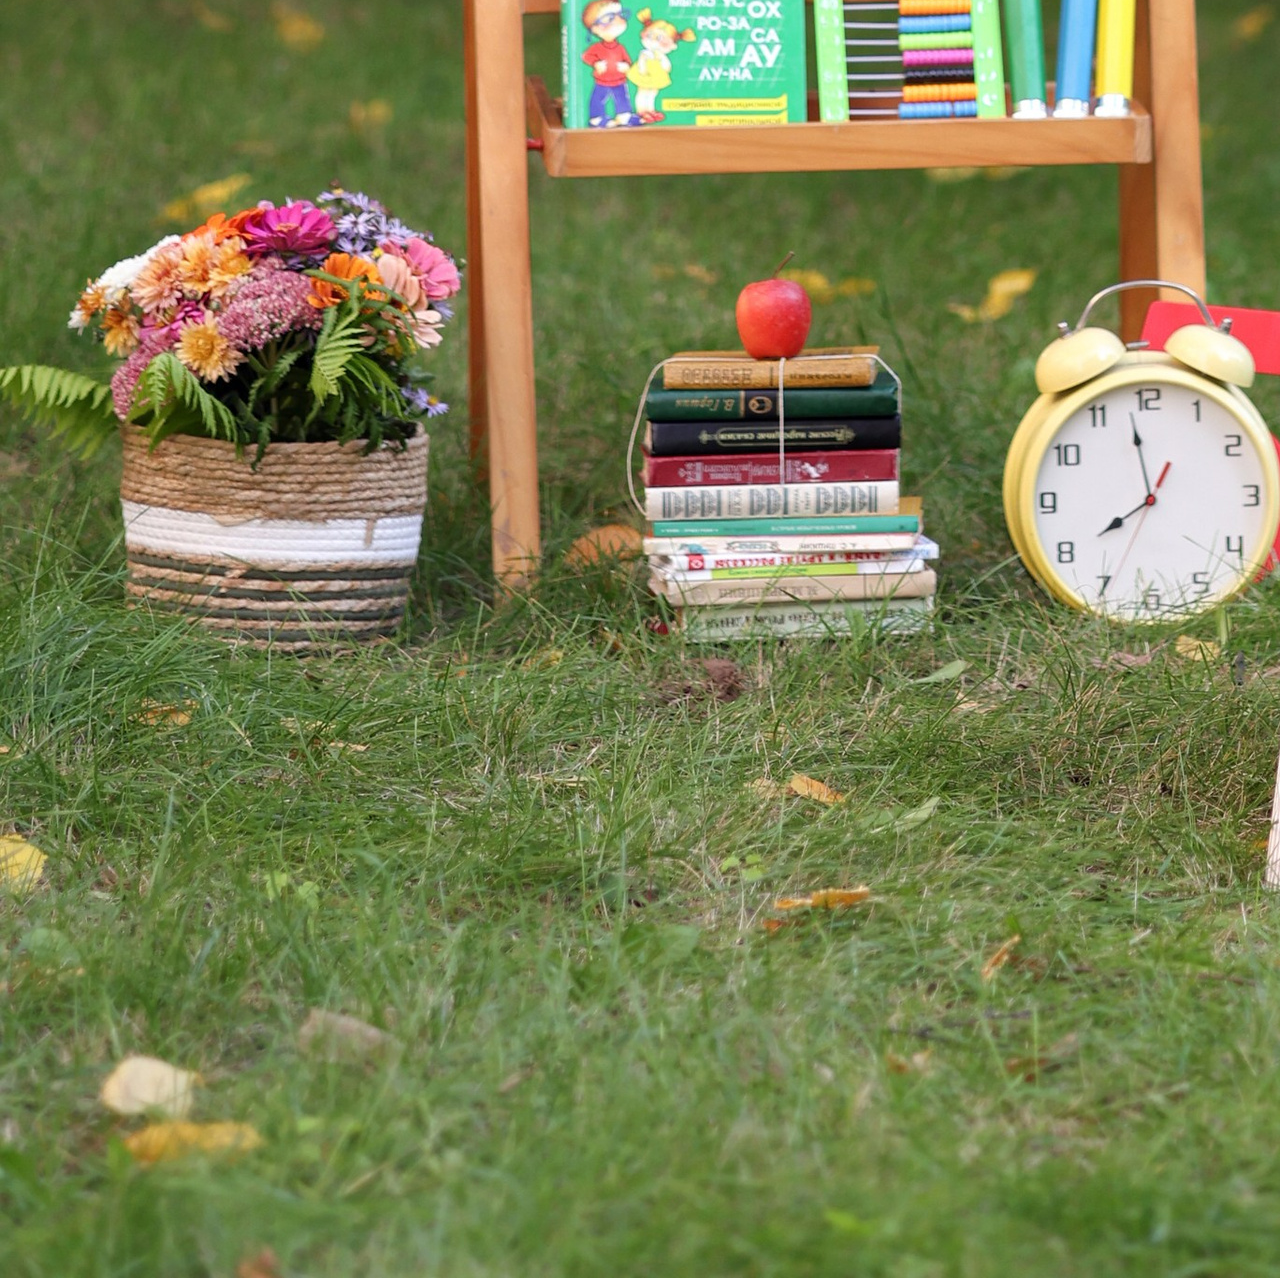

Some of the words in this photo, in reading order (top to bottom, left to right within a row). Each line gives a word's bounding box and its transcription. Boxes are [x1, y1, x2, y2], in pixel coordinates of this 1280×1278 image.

[747, 0, 782, 19] ОХ
[696, 16, 751, 30] РО-ЗА
[751, 28, 780, 43] СА
[697, 39, 735, 56] АМ
[740, 44, 782, 68] АУ
[699, 66, 753, 81] ЛУ-НА
[1134, 388, 1162, 412] 12
[1192, 399, 1202, 423] 1
[1087, 404, 1107, 428] 11
[1053, 443, 1081, 467] 10
[1224, 435, 1242, 457] 2
[1039, 491, 1057, 514] 9
[1242, 485, 1260, 507] 3
[1057, 541, 1075, 564] 8
[1226, 535, 1244, 558] 4
[1096, 575, 1112, 597] 7
[1192, 571, 1211, 594] 5
